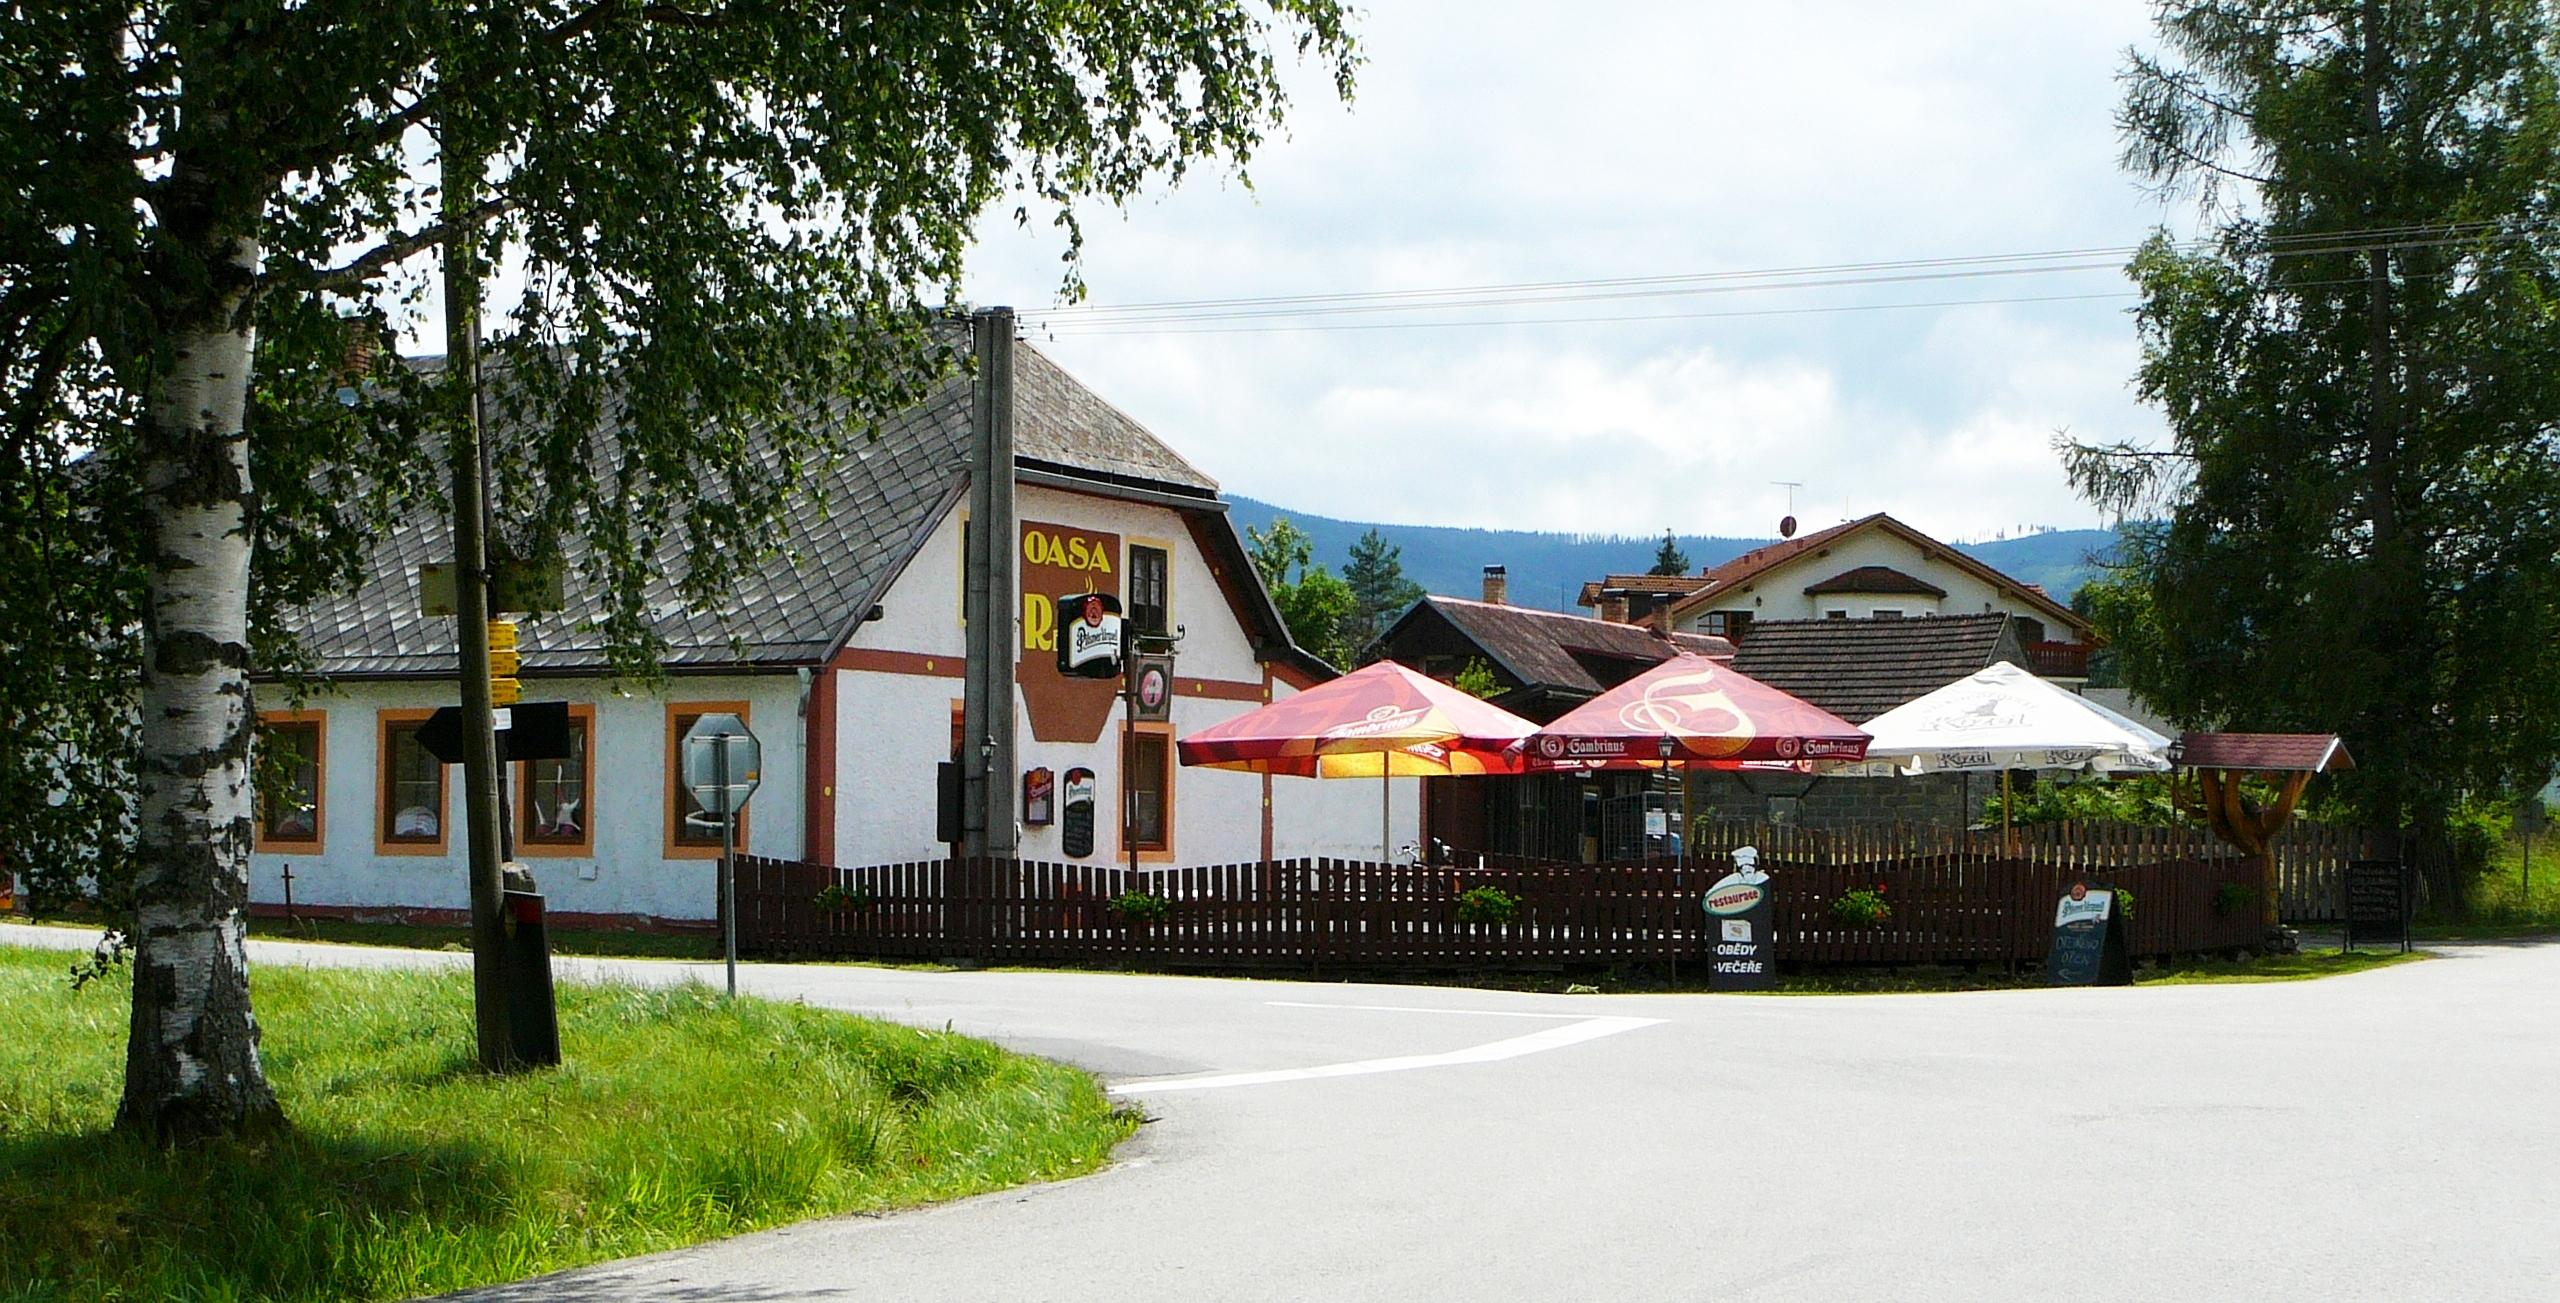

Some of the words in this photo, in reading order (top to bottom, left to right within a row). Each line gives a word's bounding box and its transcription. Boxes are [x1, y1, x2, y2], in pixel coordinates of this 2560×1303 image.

[1024, 530, 1112, 573] OASA
[1568, 739, 1625, 753] Gambrinus
[1803, 740, 1859, 754] Gambrinus
[1708, 890, 1758, 908] restaurace
[1717, 943, 1757, 956] OBĚDY
[1717, 961, 1763, 974] VEČEŘE
